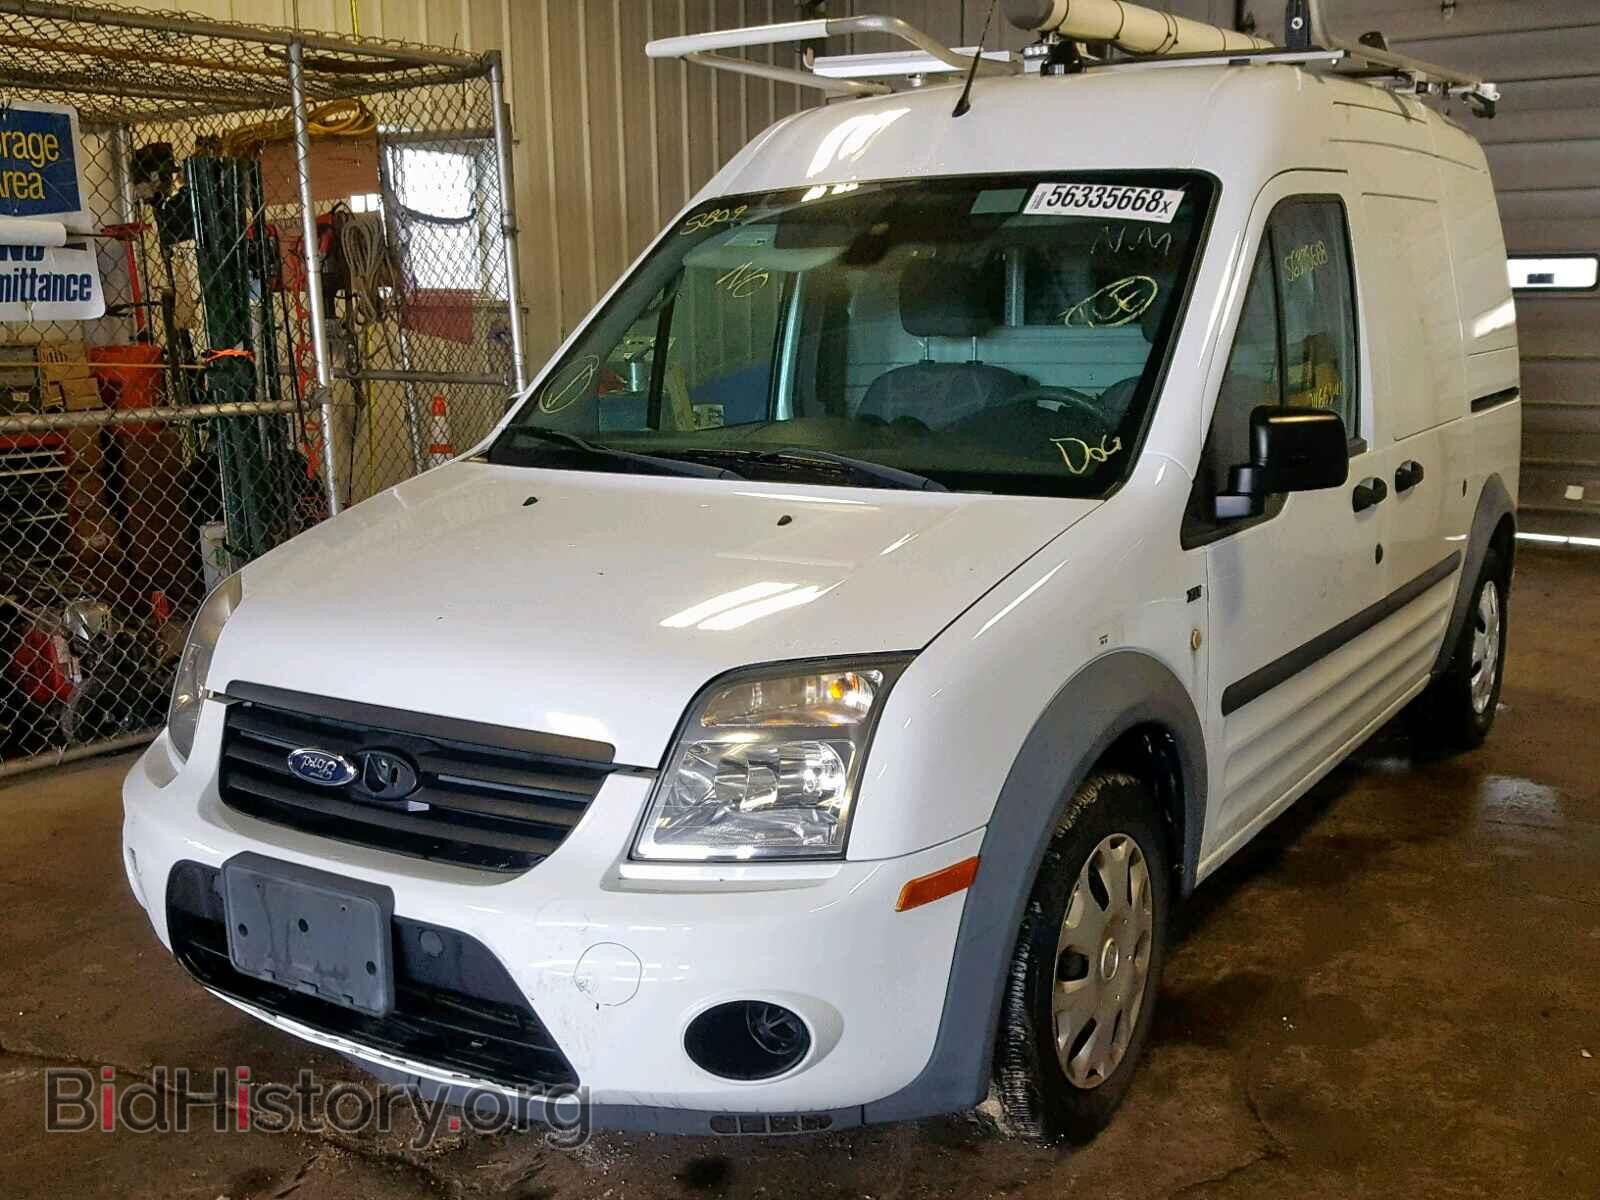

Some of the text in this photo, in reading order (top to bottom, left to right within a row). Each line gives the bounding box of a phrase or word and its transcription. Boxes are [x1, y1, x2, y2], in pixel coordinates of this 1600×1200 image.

[0, 131, 60, 168] rage
[0, 170, 46, 200] rea
[300, 755, 337, 780] Ford
